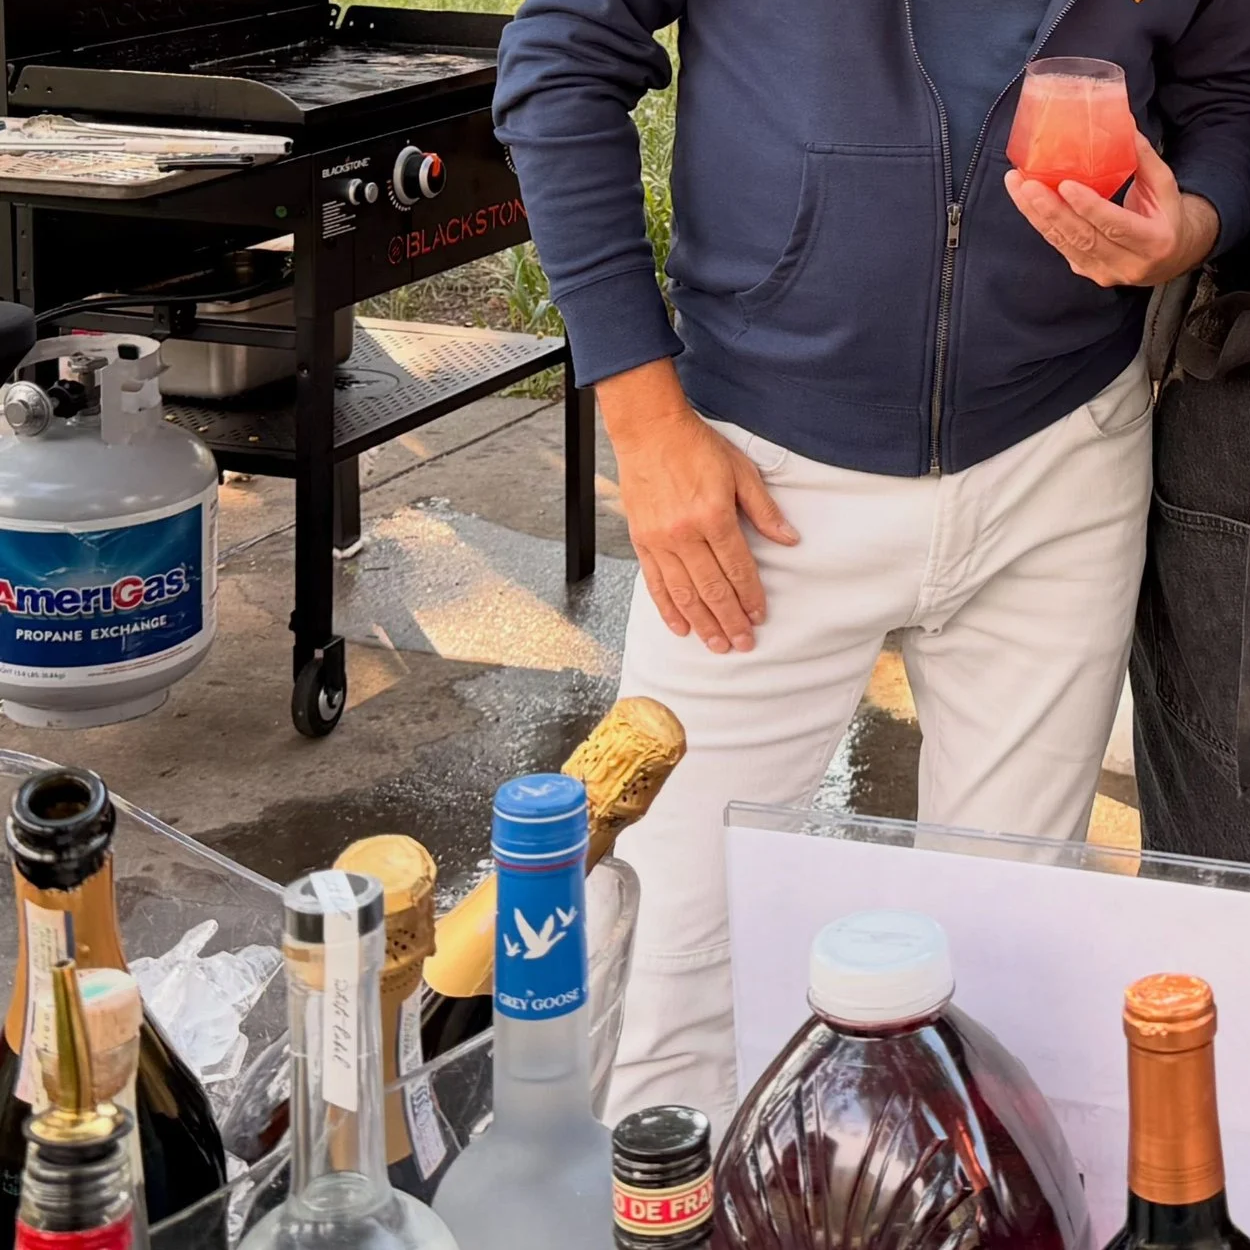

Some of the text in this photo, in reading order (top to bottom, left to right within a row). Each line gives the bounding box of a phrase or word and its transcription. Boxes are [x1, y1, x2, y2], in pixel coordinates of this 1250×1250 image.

[321, 157, 371, 179] BLACKSTONE
[16, 614, 168, 642] PROPANE EXCHANGE
[498, 987, 580, 1011] GREY GOOSE
[630, 1199, 663, 1221] DE
